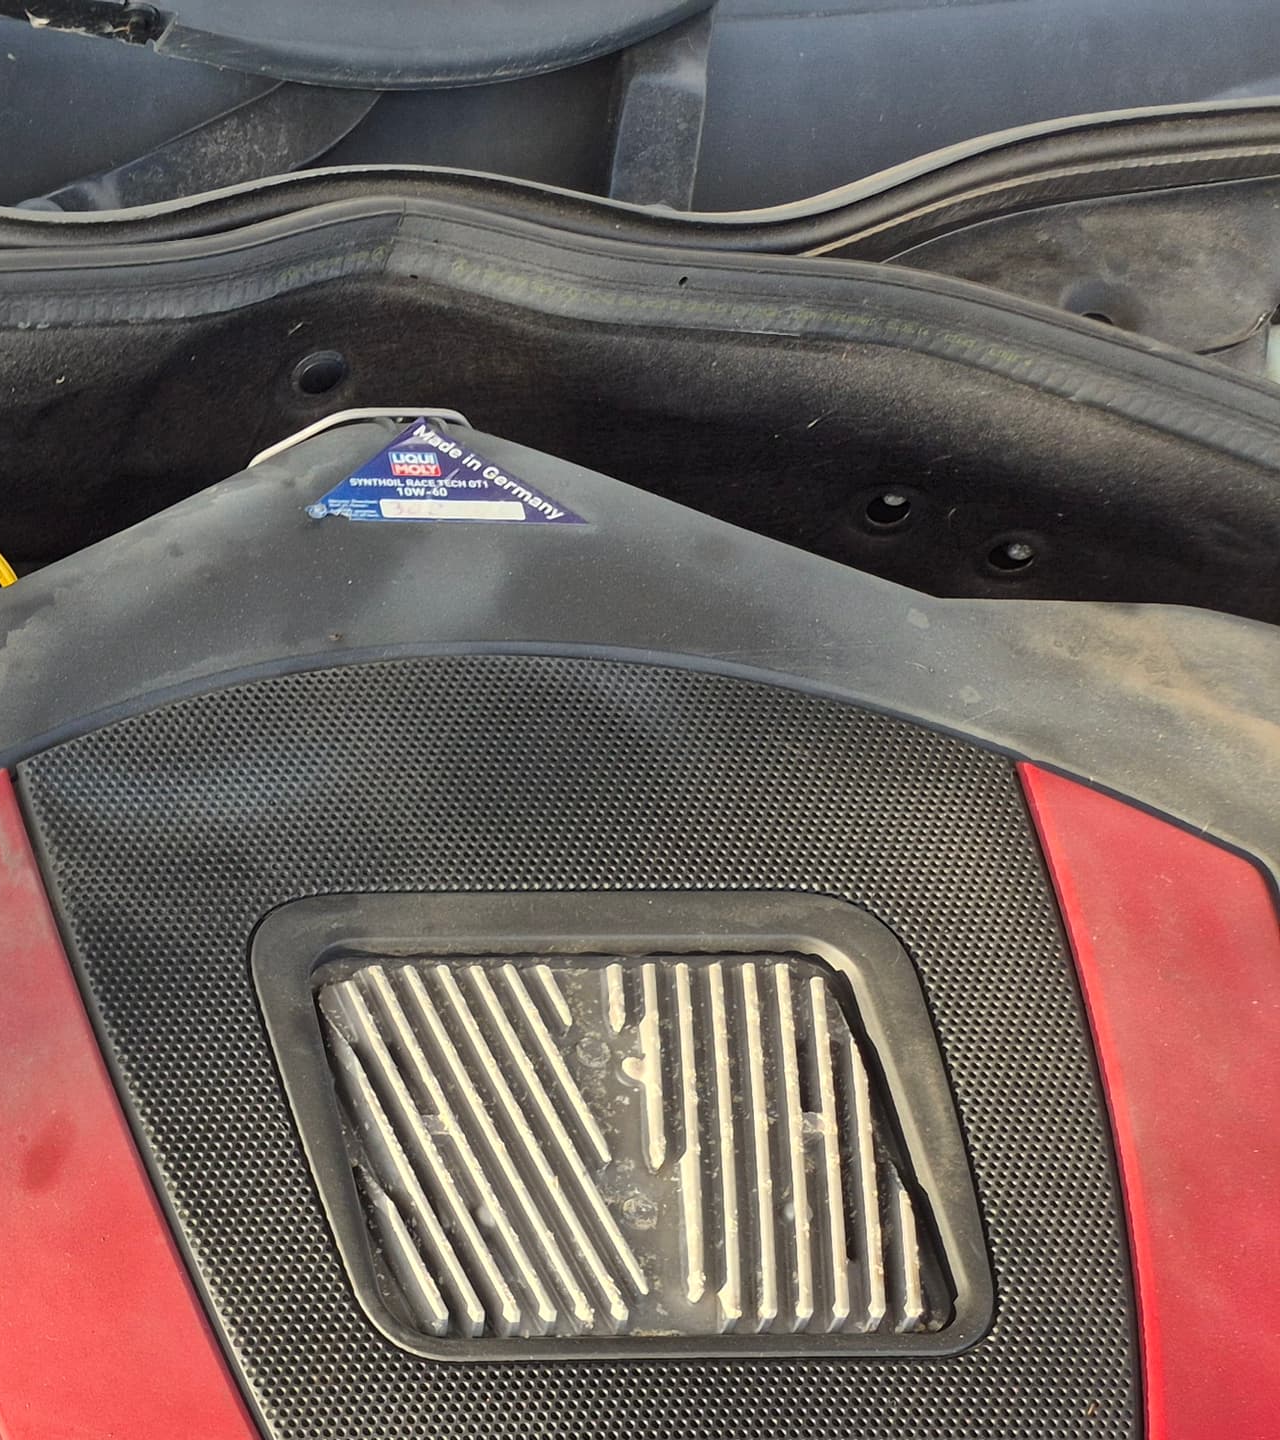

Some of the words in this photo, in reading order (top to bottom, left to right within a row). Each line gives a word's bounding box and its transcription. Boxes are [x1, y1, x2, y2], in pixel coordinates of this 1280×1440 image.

[392, 453, 436, 464] LIQUI
[394, 465, 437, 475] MOLY
[413, 424, 463, 459] Made
[462, 453, 482, 471] in
[482, 466, 565, 520] Germany
[349, 478, 404, 487] SYNTHOIL
[405, 478, 435, 487] RACE
[436, 479, 467, 488] TECH
[396, 487, 448, 497] 10W-60
